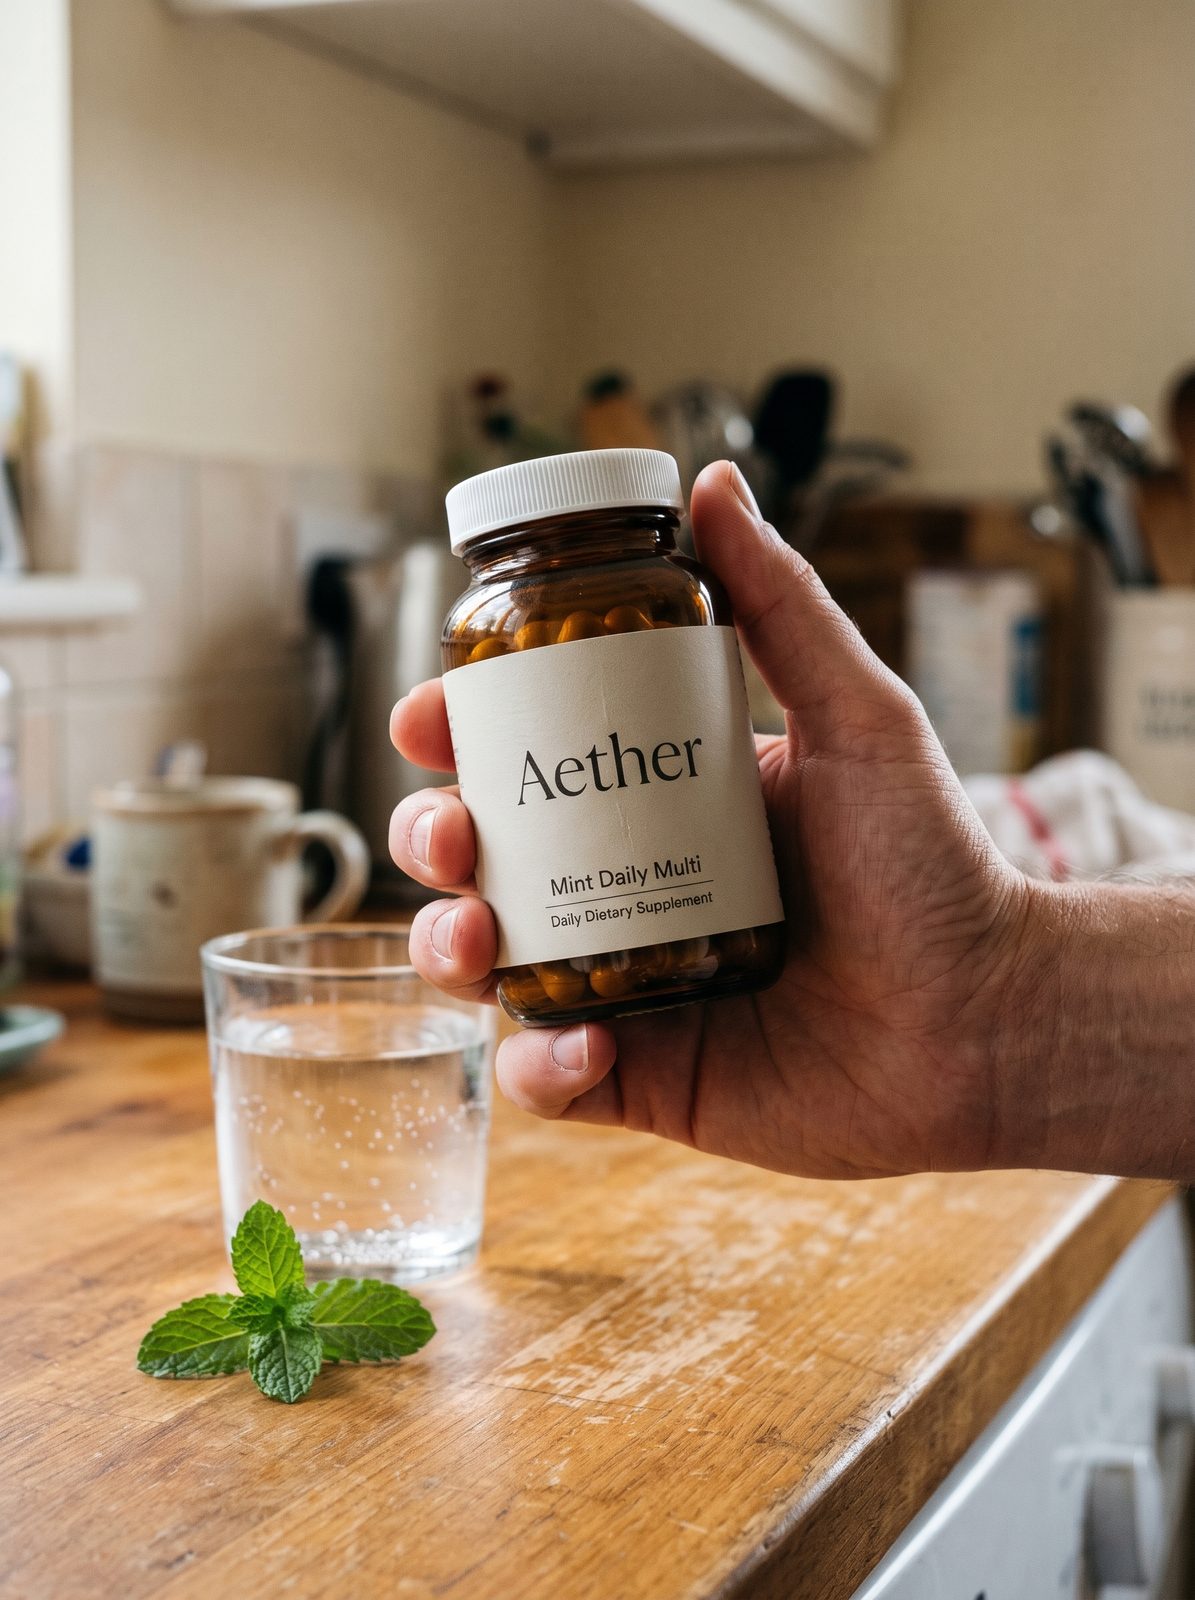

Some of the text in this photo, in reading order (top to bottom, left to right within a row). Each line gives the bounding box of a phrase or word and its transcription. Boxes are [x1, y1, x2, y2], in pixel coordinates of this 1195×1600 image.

[517, 731, 703, 806] Aether
[550, 854, 702, 897] Mint Daily Multi
[550, 891, 713, 928] Daily Dietary Supplement
